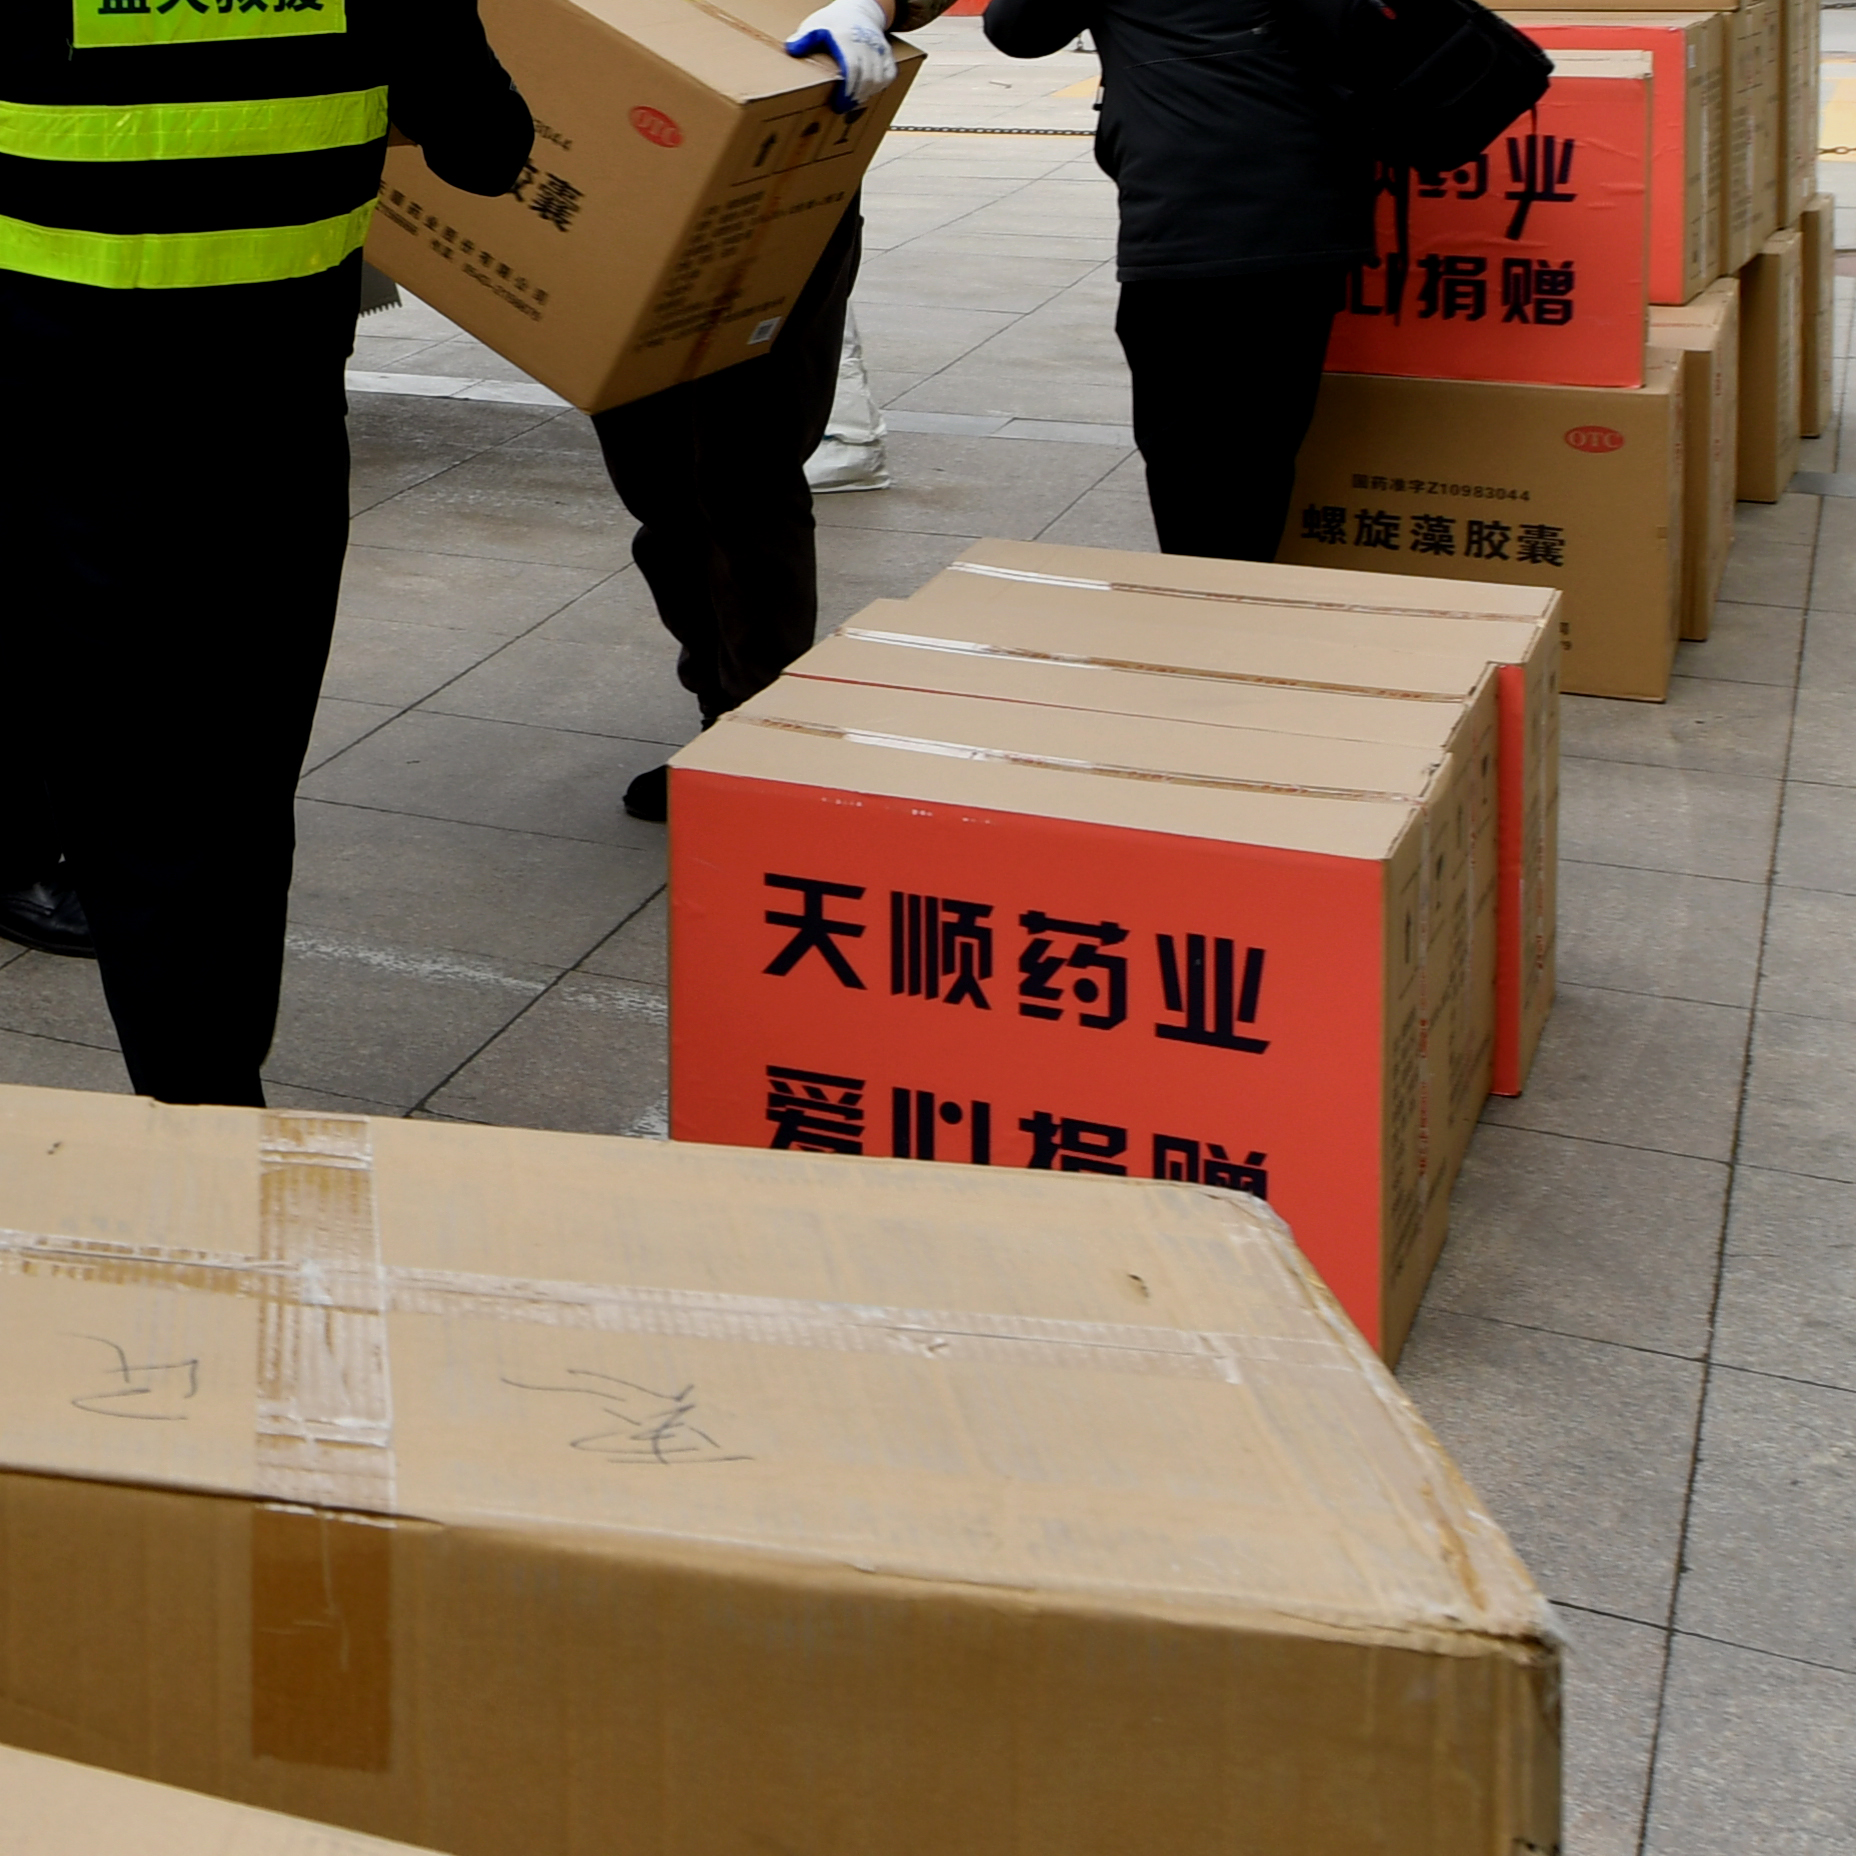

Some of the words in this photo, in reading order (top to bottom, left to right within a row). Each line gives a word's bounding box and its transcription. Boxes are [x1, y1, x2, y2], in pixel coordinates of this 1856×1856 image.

[1567, 429, 1621, 449] OTC
[1352, 474, 1531, 502] 国药准字Z10983044
[1300, 503, 1566, 568] 螺旋藻胶囊
[762, 872, 1271, 1055] 天顺药业
